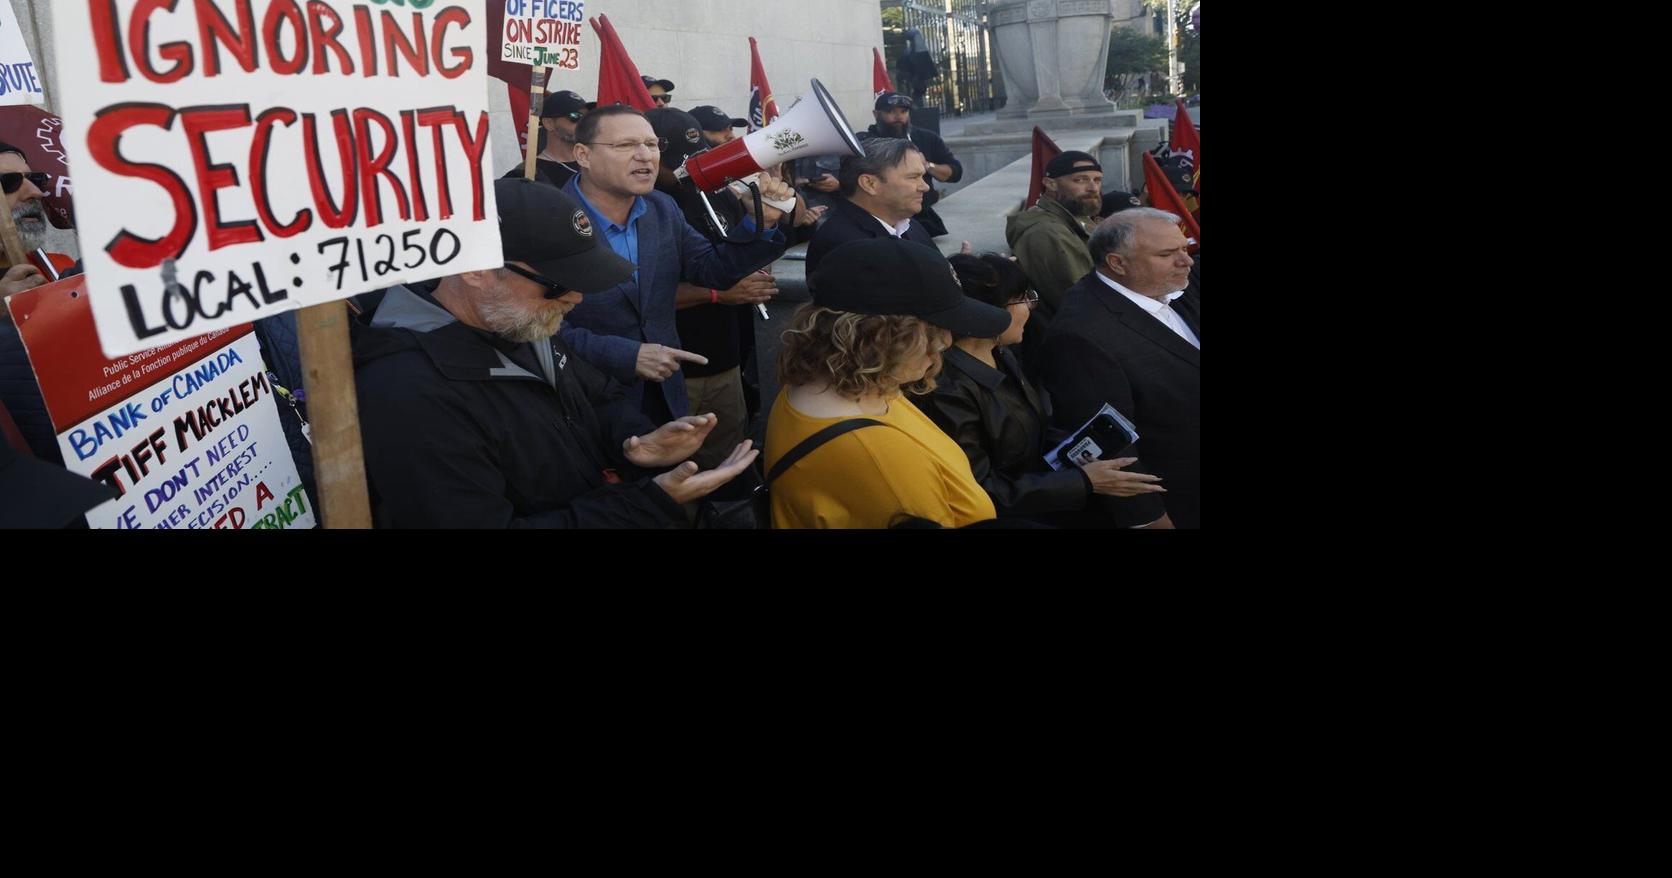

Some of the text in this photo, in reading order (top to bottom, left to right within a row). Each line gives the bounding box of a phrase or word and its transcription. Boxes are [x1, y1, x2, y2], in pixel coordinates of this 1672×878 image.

[88, 0, 474, 84] IGNORING
[504, 43, 532, 60] SINCE
[559, 48, 579, 69] 23
[506, 18, 582, 45] ON STRIKE
[86, 101, 490, 269] SECURITY
[317, 227, 462, 290] 71250
[88, 378, 121, 401] Alliance
[122, 374, 132, 386] de
[132, 369, 141, 380] la
[141, 355, 172, 375] Fonction
[172, 340, 199, 361] publique
[102, 348, 157, 378] Public Service
[68, 401, 148, 462] BANK
[172, 347, 243, 400] CANADA
[91, 371, 270, 501] TIFF MACKLEM
[143, 456, 200, 514] DON'T
[206, 424, 250, 467] NEED
[153, 441, 258, 529] HER INTEREST
[209, 480, 275, 529] ED A
